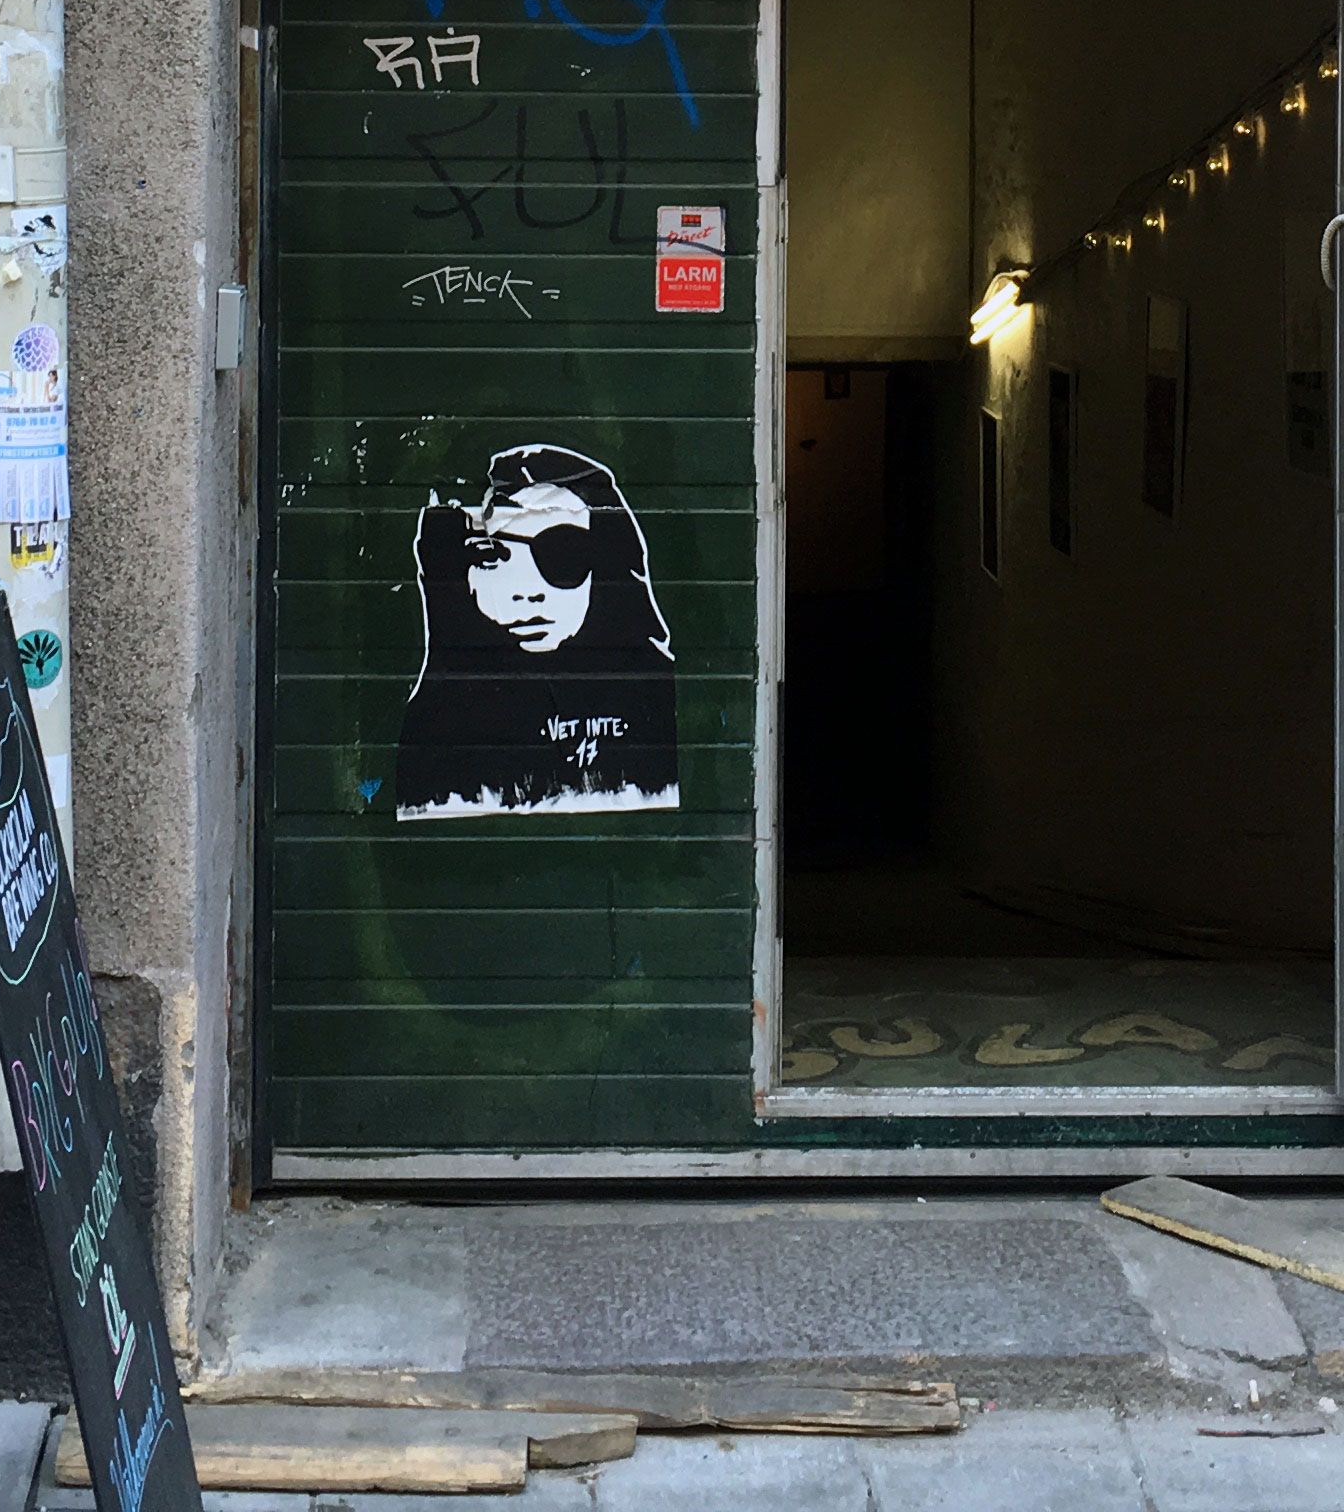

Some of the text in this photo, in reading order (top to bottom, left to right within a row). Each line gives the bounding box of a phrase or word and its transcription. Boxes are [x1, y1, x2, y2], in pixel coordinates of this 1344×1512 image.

[663, 266, 716, 282] LARM
[547, 715, 623, 740] VET INTE
[1, 847, 45, 952] BREWING
